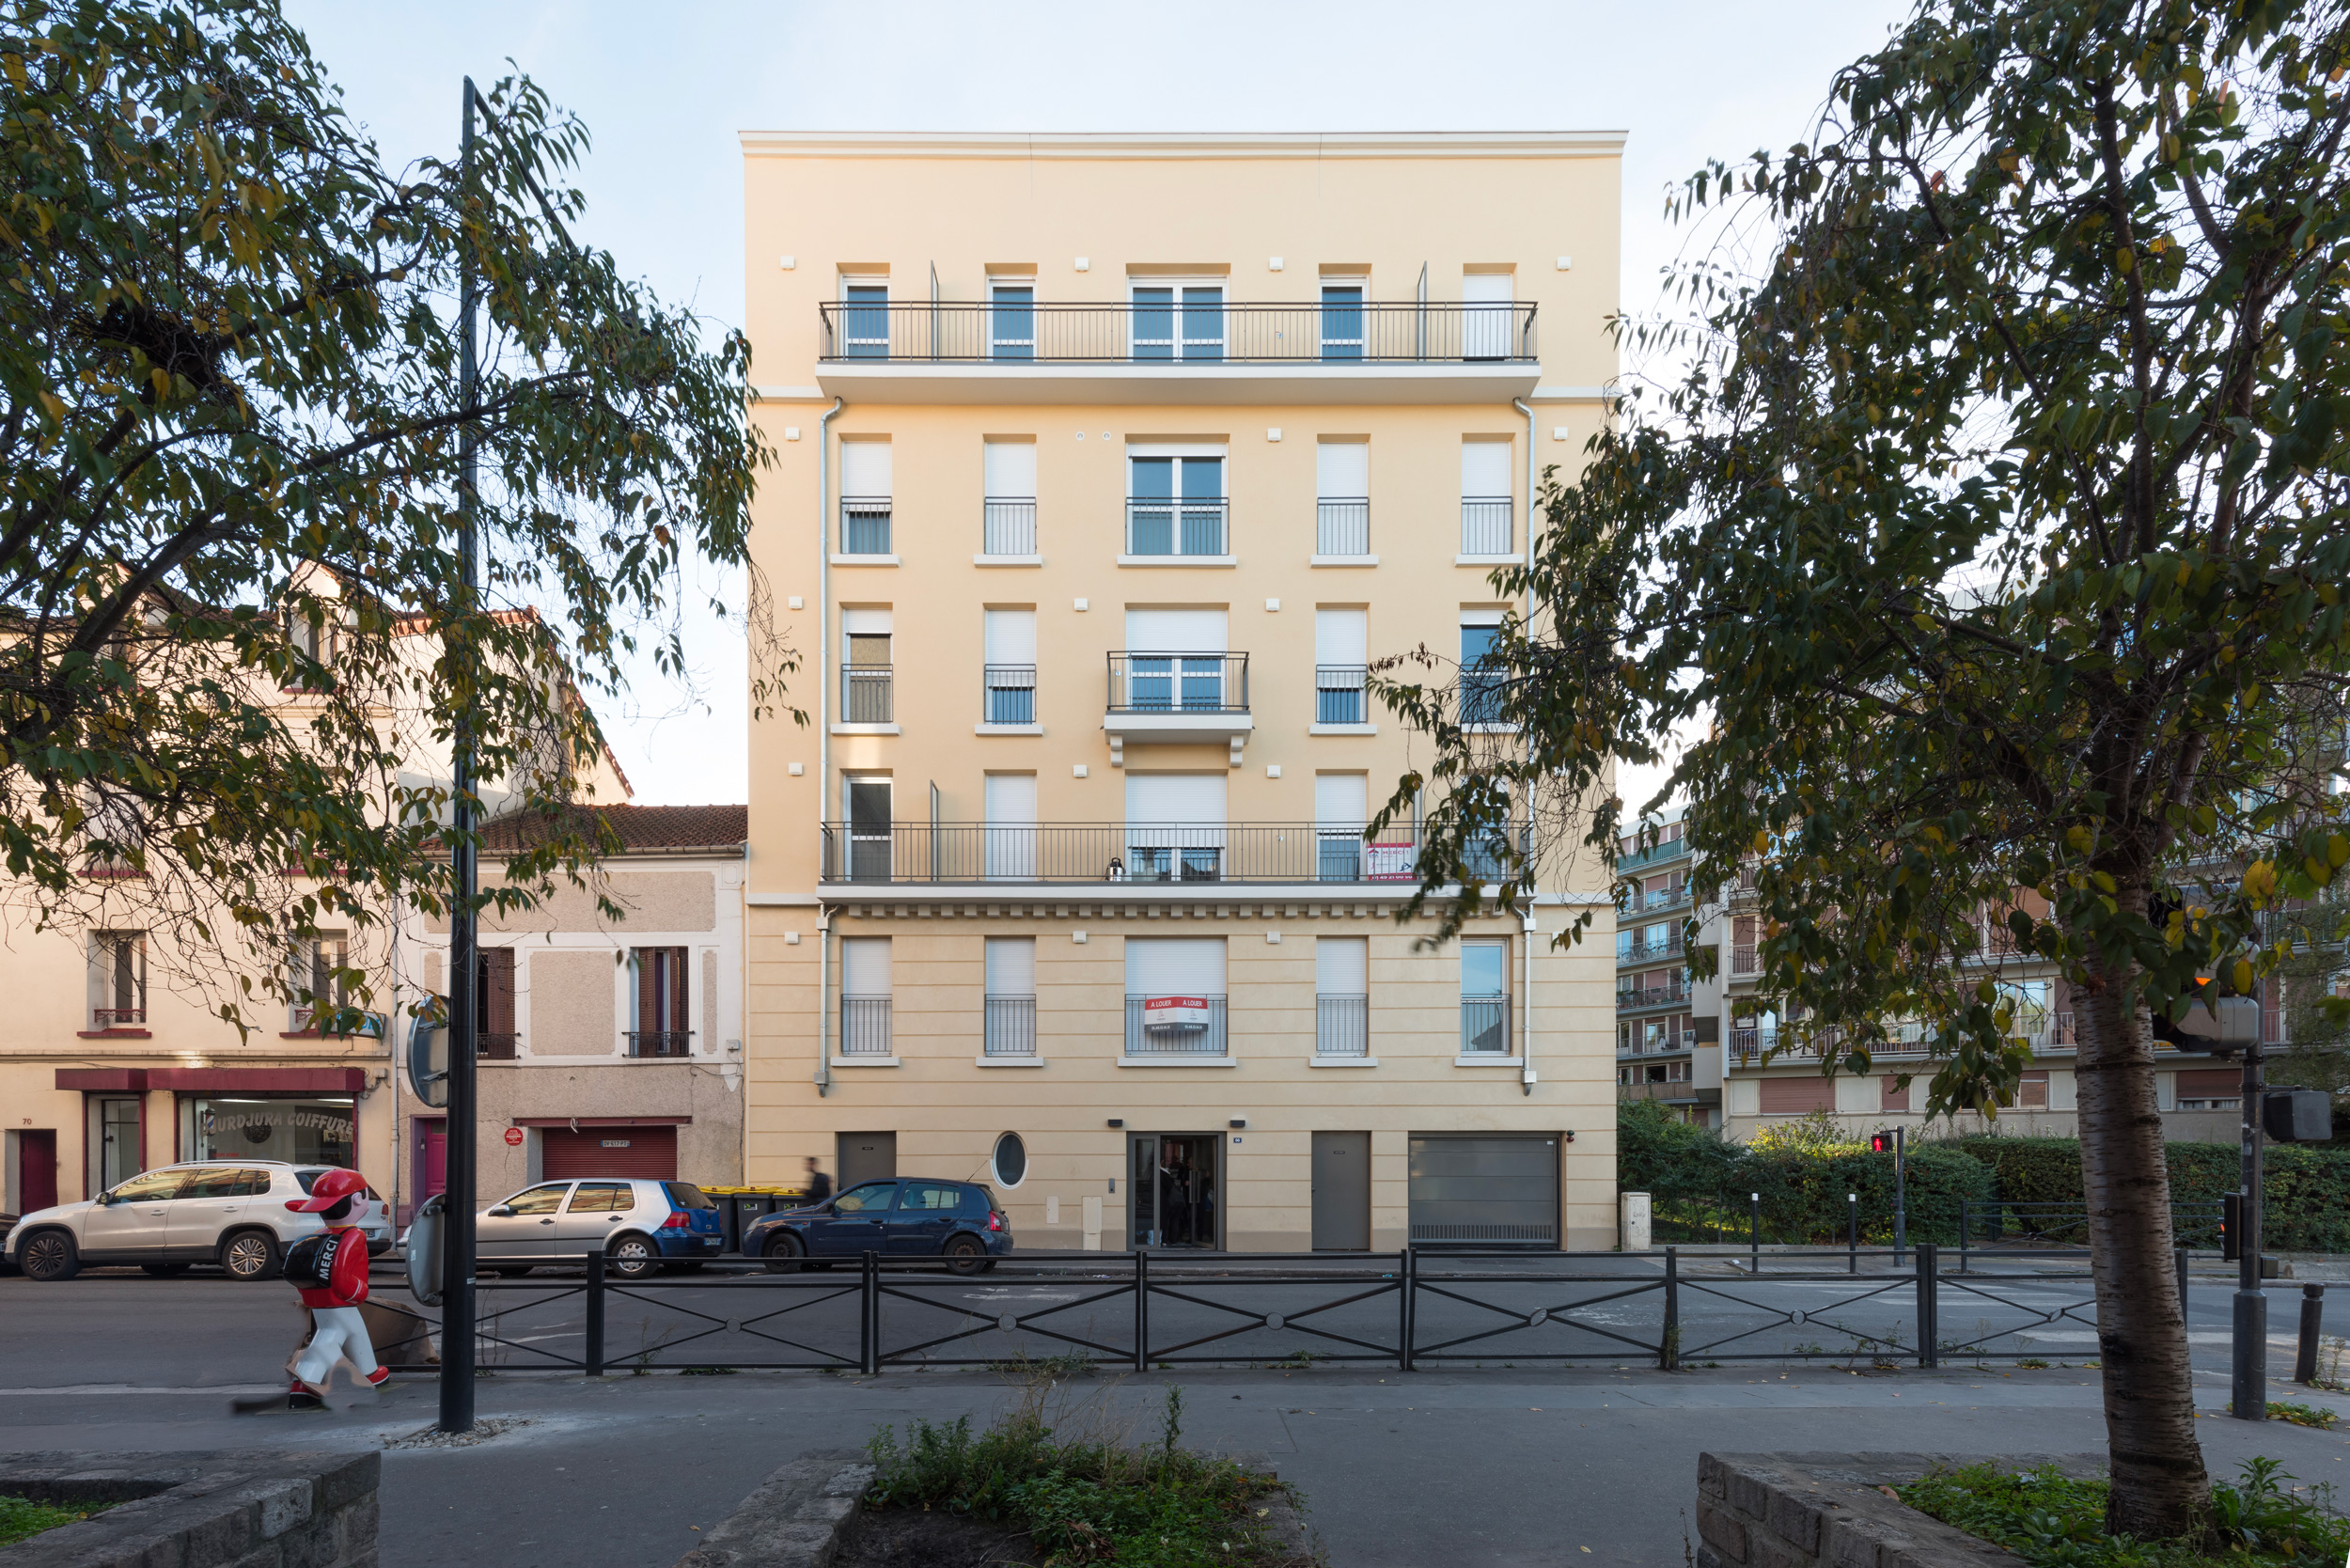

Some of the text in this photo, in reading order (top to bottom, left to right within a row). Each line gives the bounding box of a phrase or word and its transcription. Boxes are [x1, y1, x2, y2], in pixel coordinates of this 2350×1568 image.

[1155, 999, 1172, 1008] LOUER
[287, 1112, 353, 1136] COIFFURE
[319, 1239, 338, 1280] MERCI
